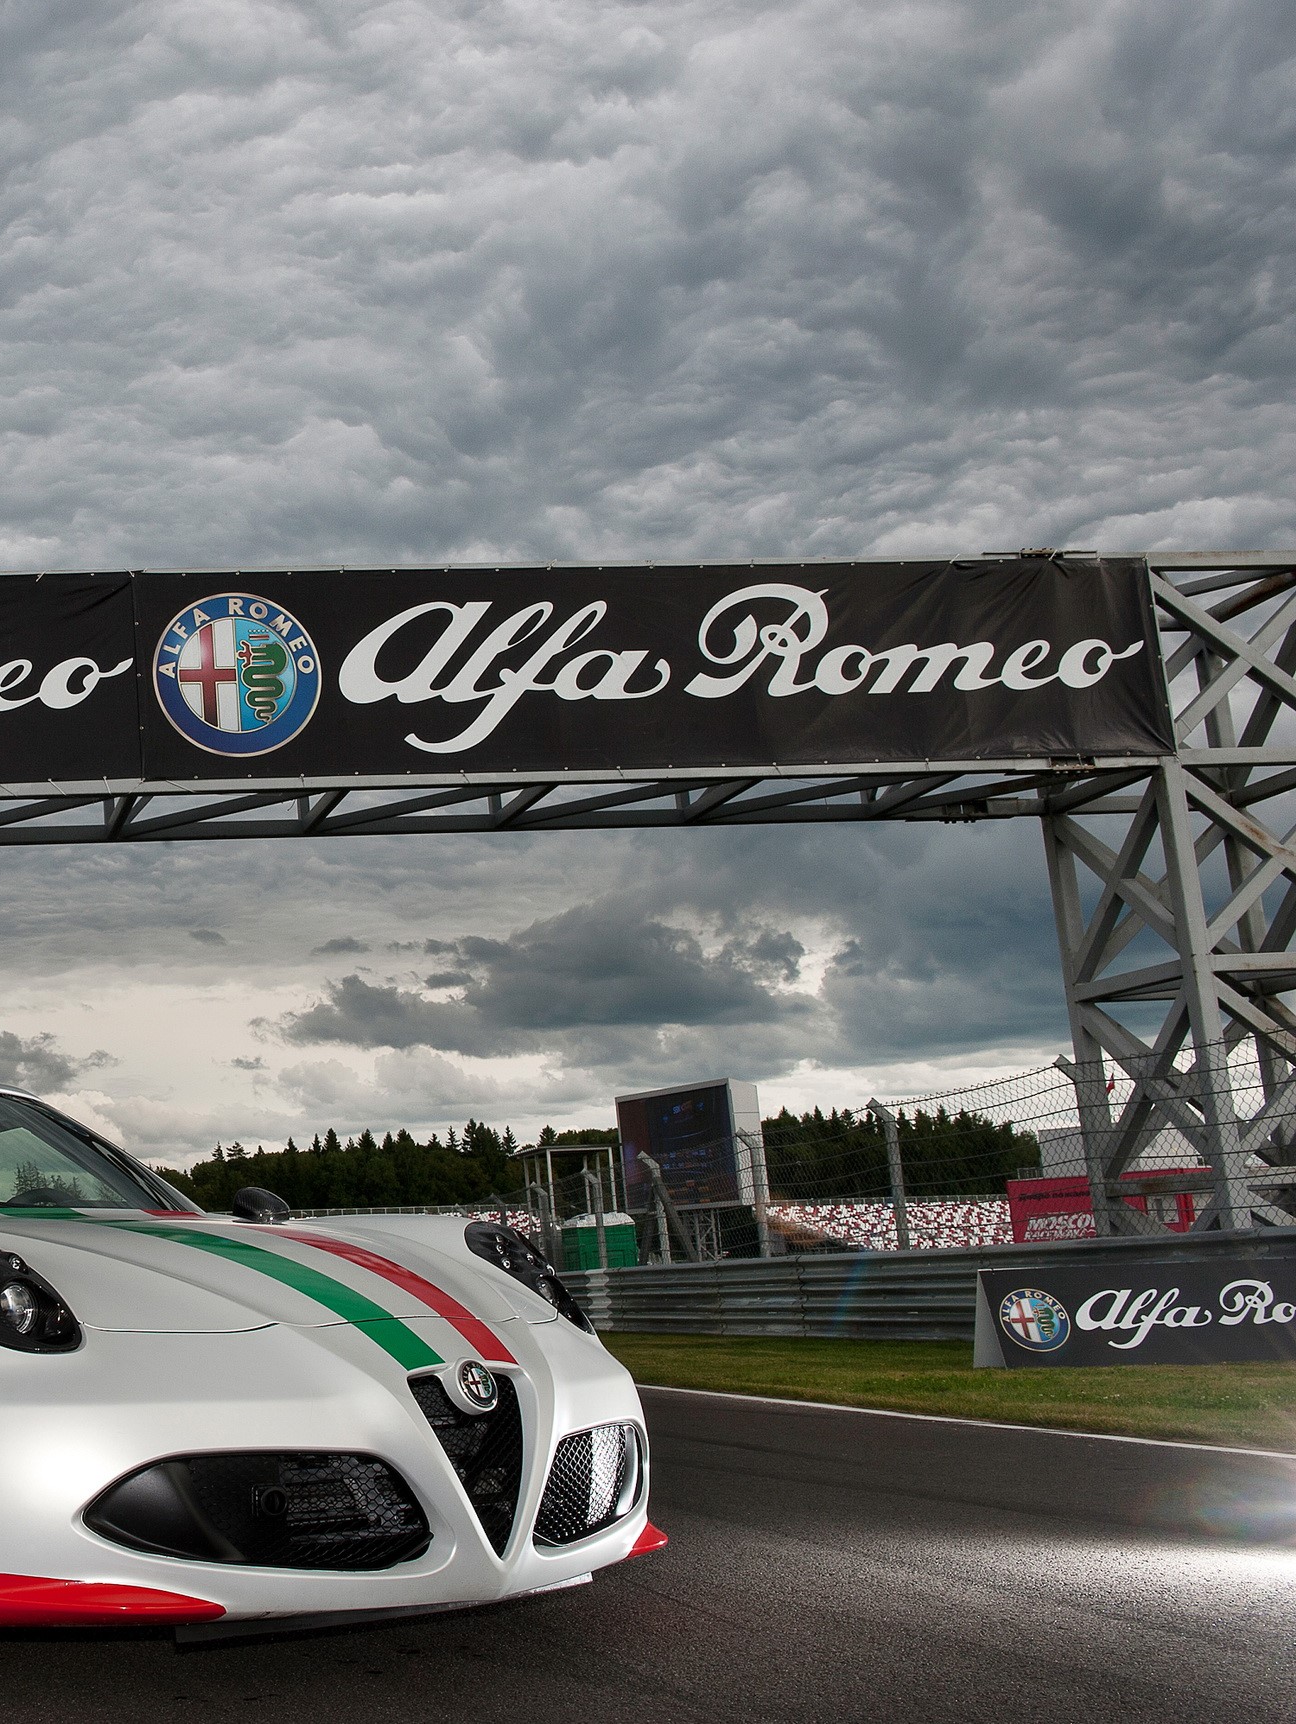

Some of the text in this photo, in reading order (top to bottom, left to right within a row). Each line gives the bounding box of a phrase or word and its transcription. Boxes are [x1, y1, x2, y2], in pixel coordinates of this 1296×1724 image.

[159, 598, 315, 679] ALFA ROMEO
[339, 583, 1144, 754] Alfa Romeo
[1027, 1213, 1096, 1231] MOSCO
[1002, 1290, 1066, 1322] ALFA ROMEO
[1075, 1287, 1213, 1350] Alfa
